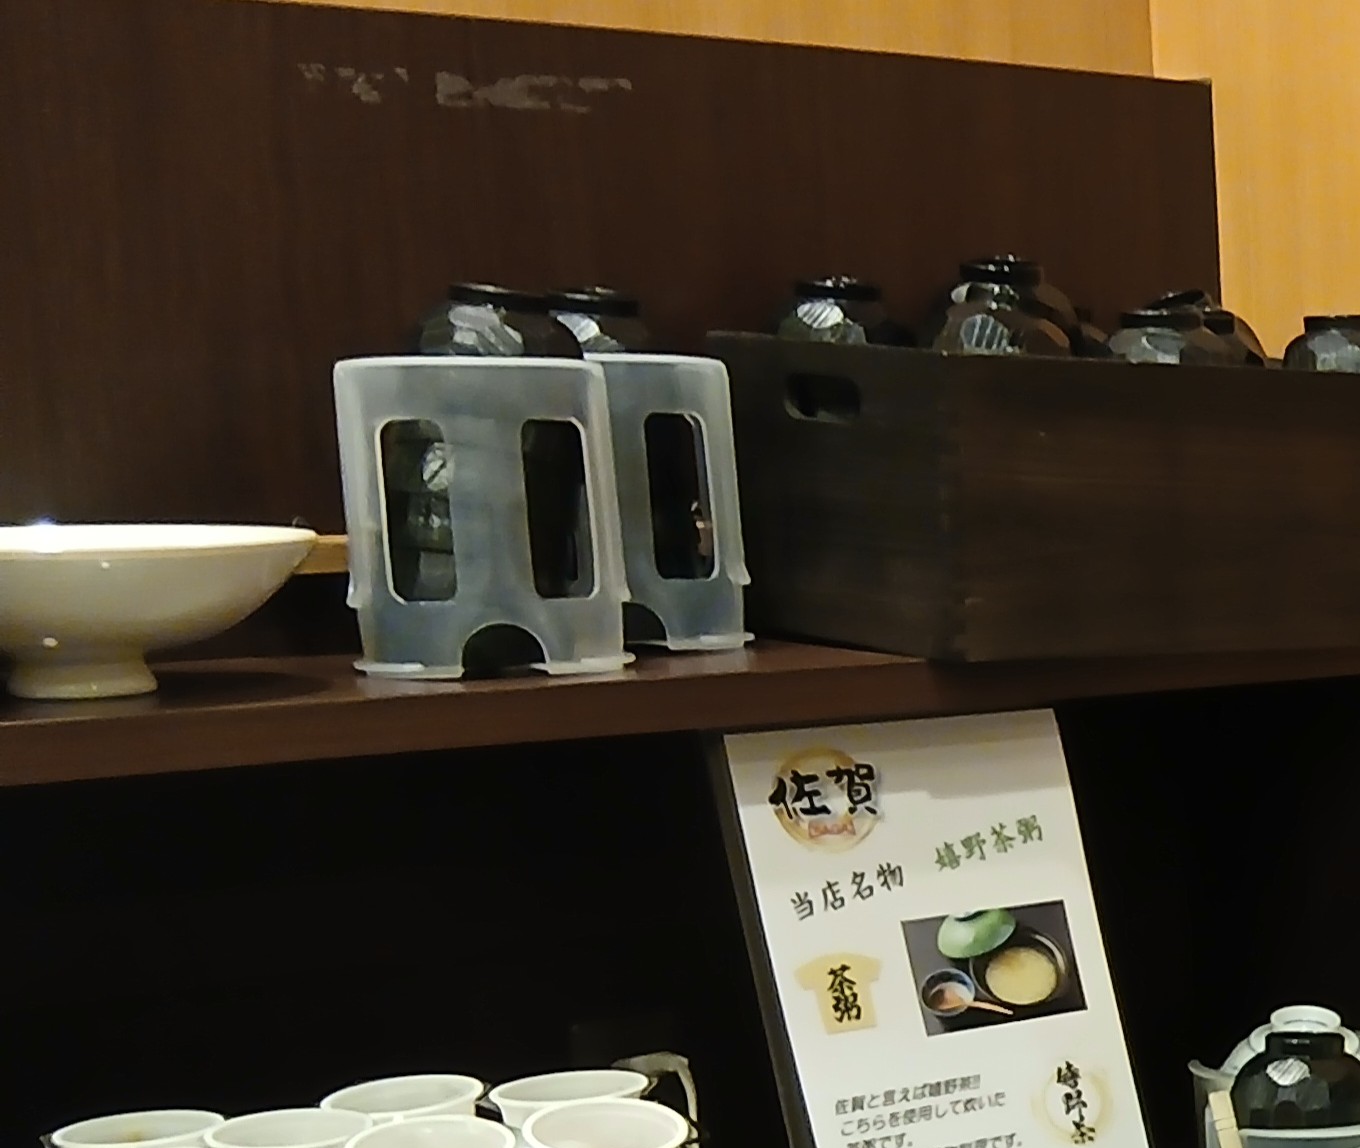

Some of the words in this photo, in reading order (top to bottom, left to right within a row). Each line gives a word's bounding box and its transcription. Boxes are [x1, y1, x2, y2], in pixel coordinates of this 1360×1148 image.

[768, 763, 877, 820] 佐賀
[934, 814, 1044, 872] 嬉野茶粥
[790, 861, 905, 921] 当店名物
[827, 963, 862, 1023] 茶粥
